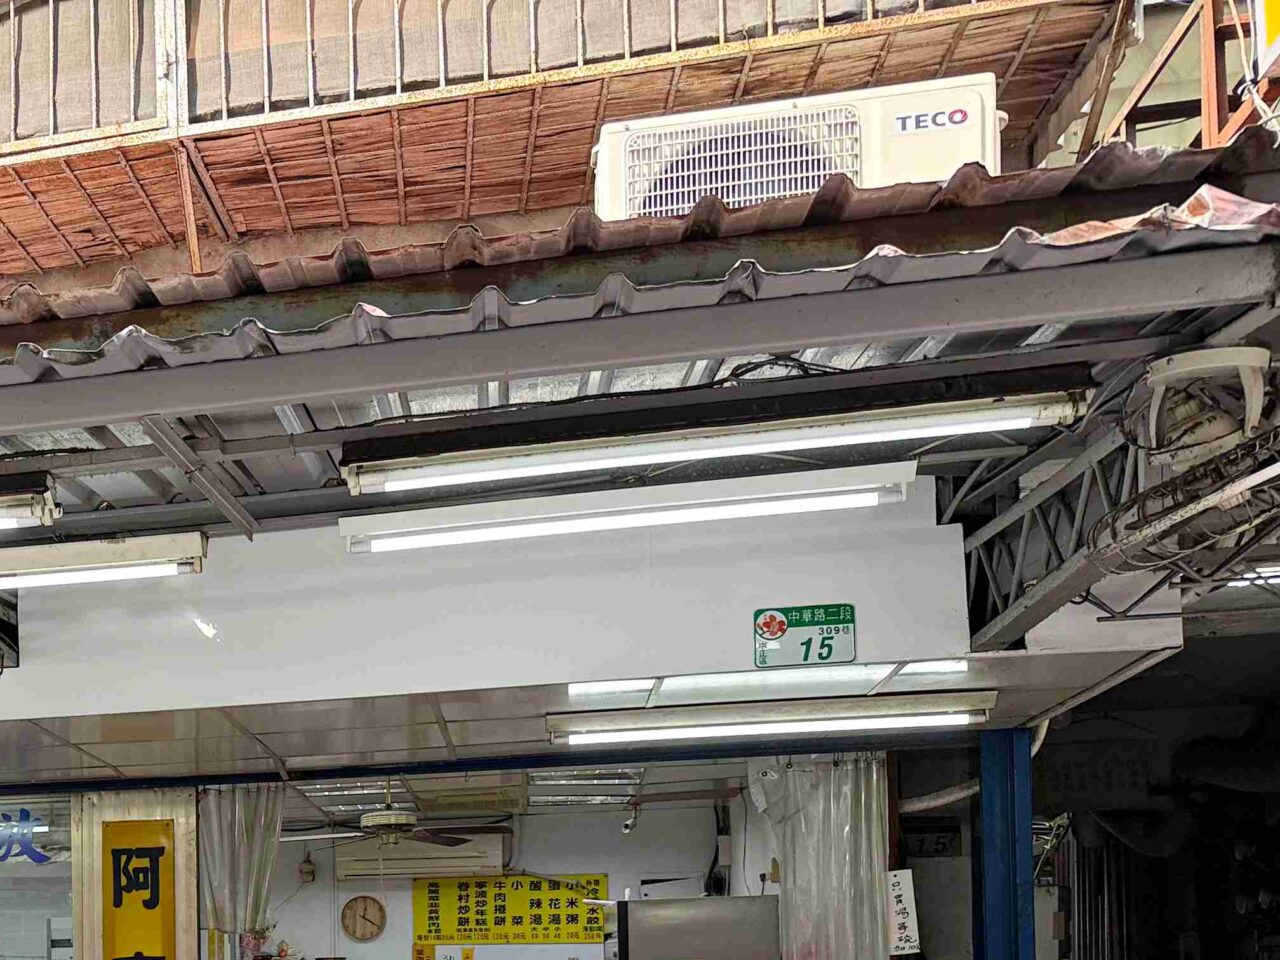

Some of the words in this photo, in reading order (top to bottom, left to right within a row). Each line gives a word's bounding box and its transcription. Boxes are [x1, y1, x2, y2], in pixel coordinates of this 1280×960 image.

[896, 109, 968, 131] TECO
[788, 606, 852, 622] 中華路二段
[800, 636, 835, 662] 15
